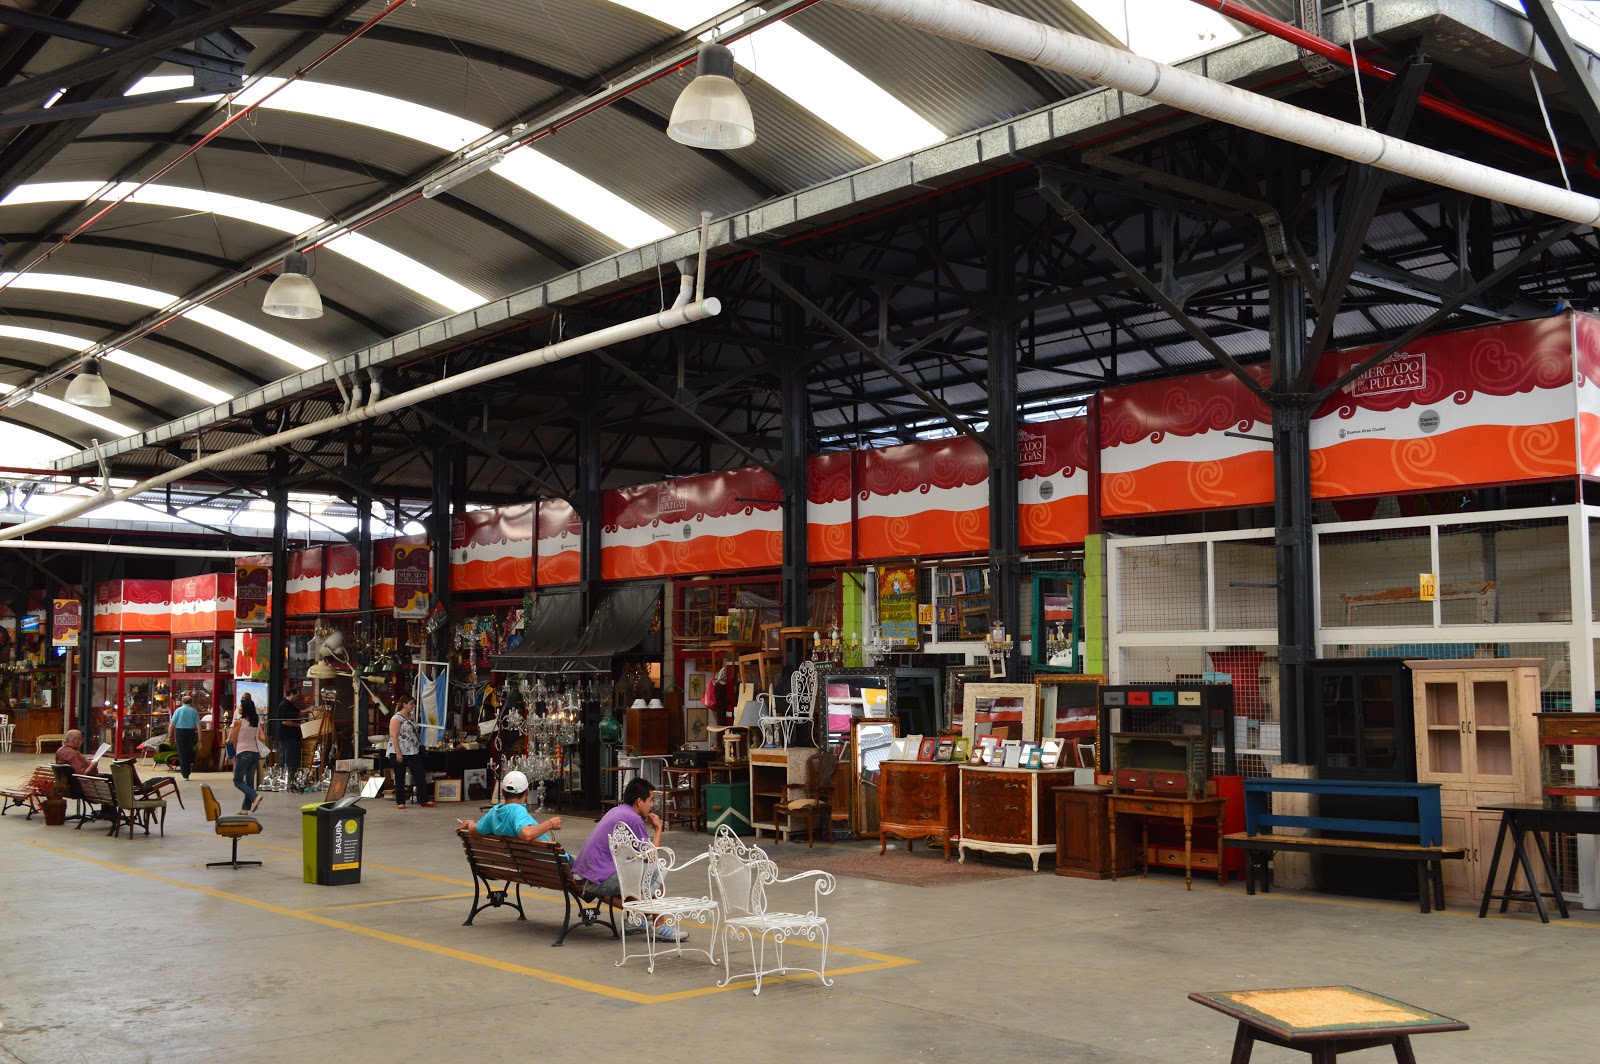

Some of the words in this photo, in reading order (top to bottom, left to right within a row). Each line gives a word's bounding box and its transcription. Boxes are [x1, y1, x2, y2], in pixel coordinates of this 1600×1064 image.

[1370, 372, 1419, 389] PULGAS
[1018, 441, 1042, 452] CADO
[1422, 585, 1434, 596] 112
[920, 612, 933, 621] 113
